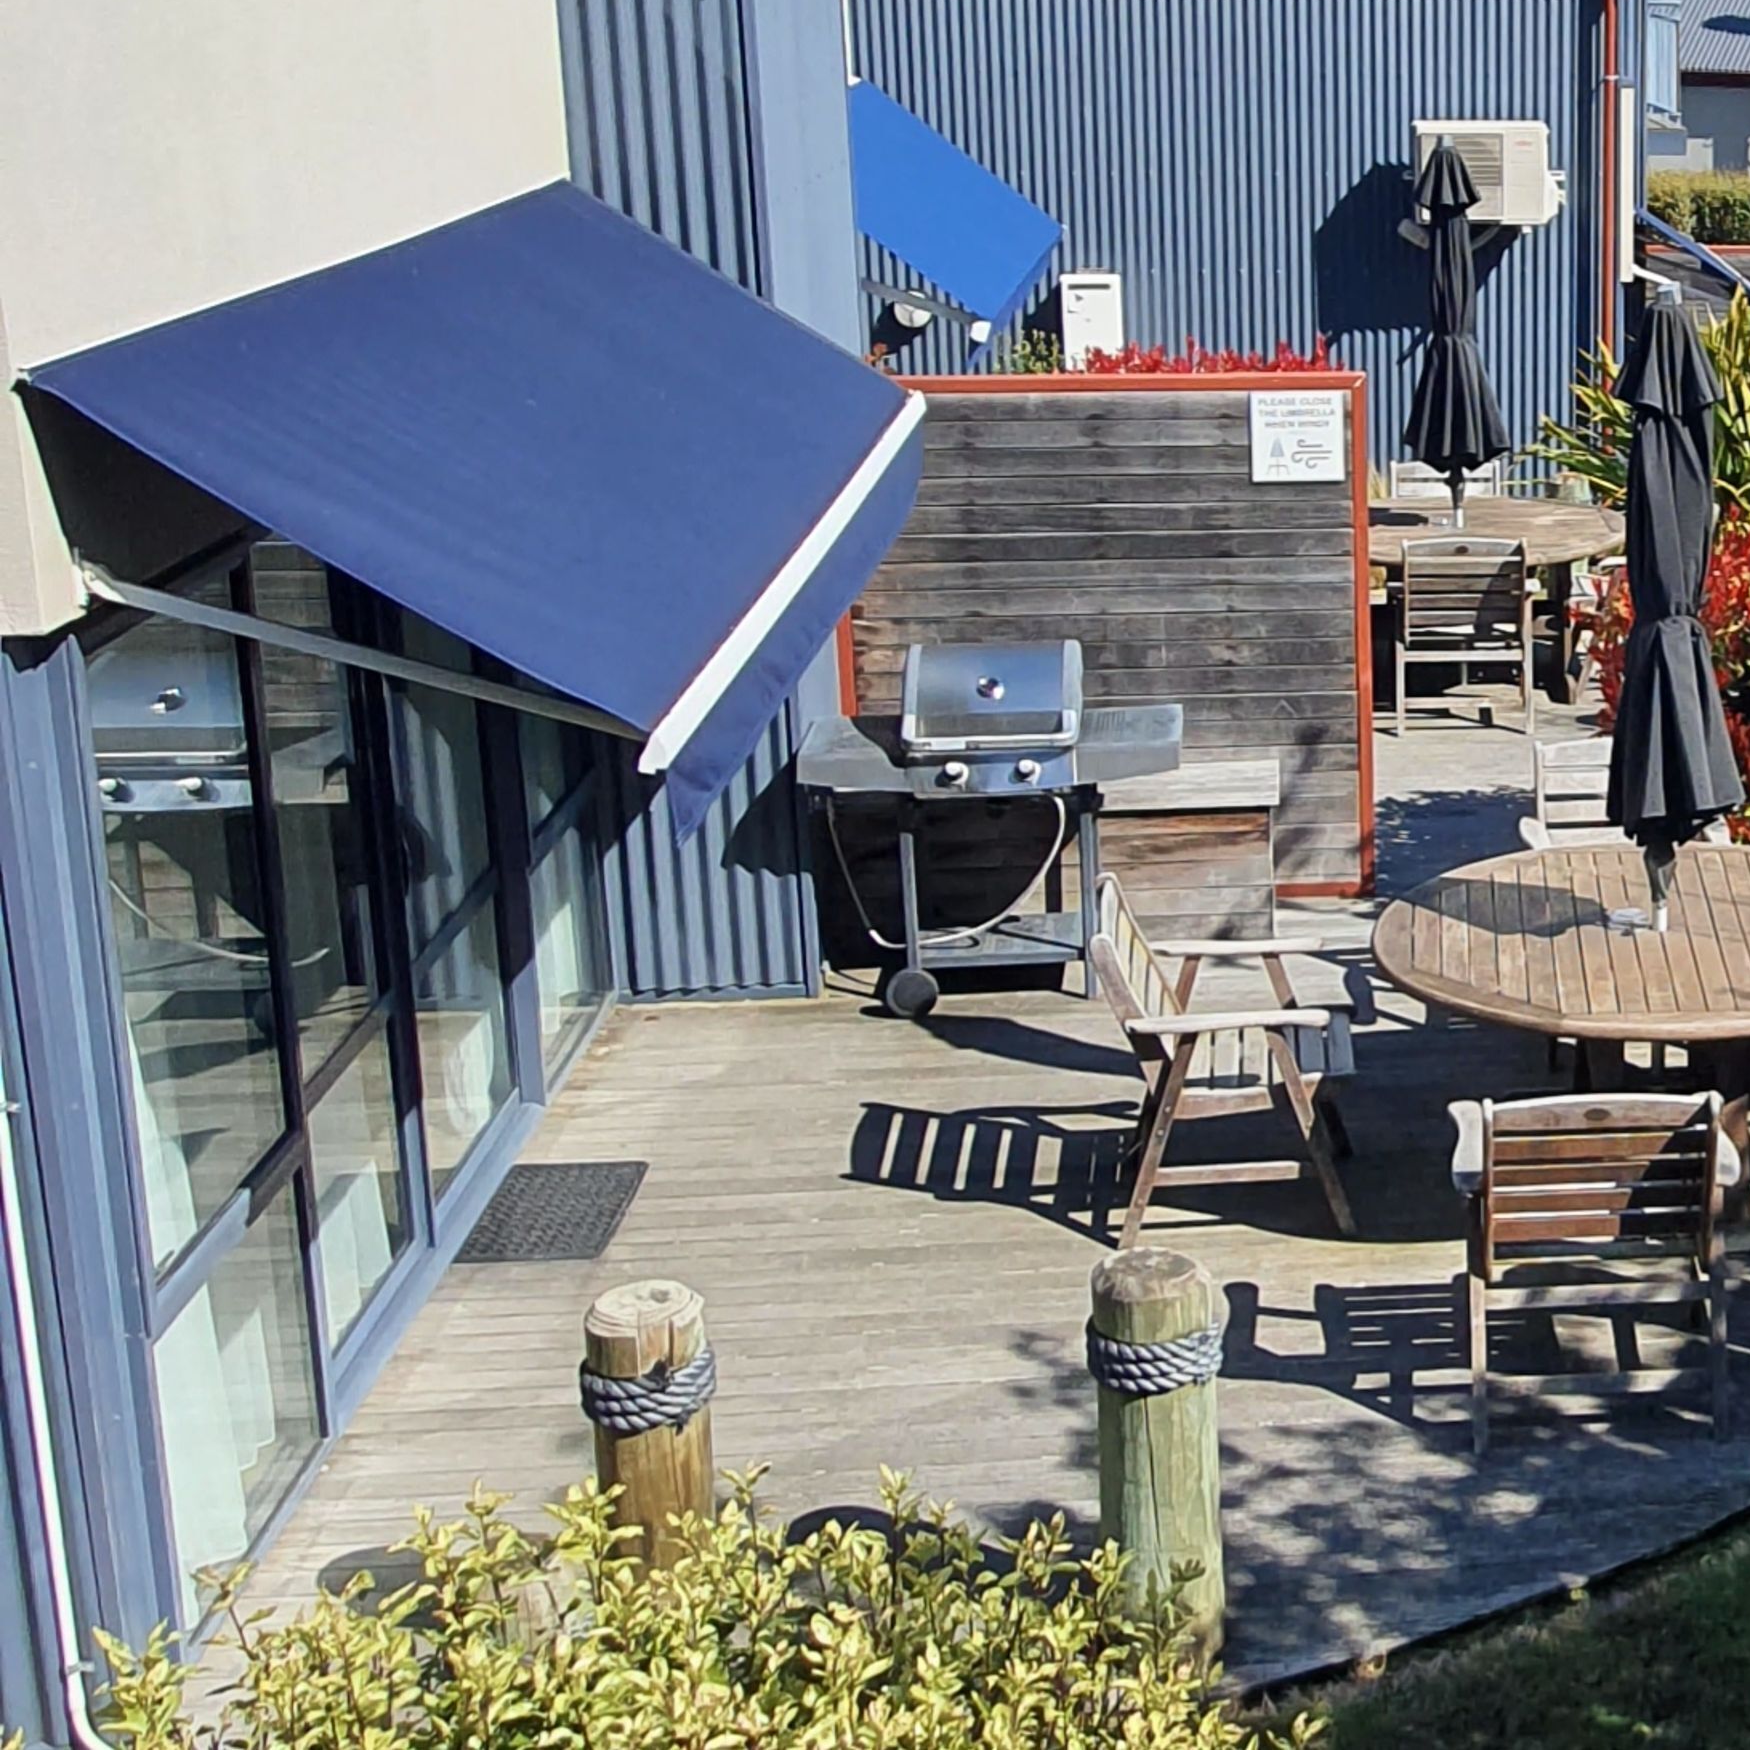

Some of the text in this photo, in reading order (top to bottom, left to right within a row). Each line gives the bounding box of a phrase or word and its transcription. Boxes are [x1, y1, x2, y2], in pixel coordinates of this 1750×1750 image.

[1258, 398, 1332, 406] PLEASE CLOSE
[1258, 409, 1278, 417] THE
